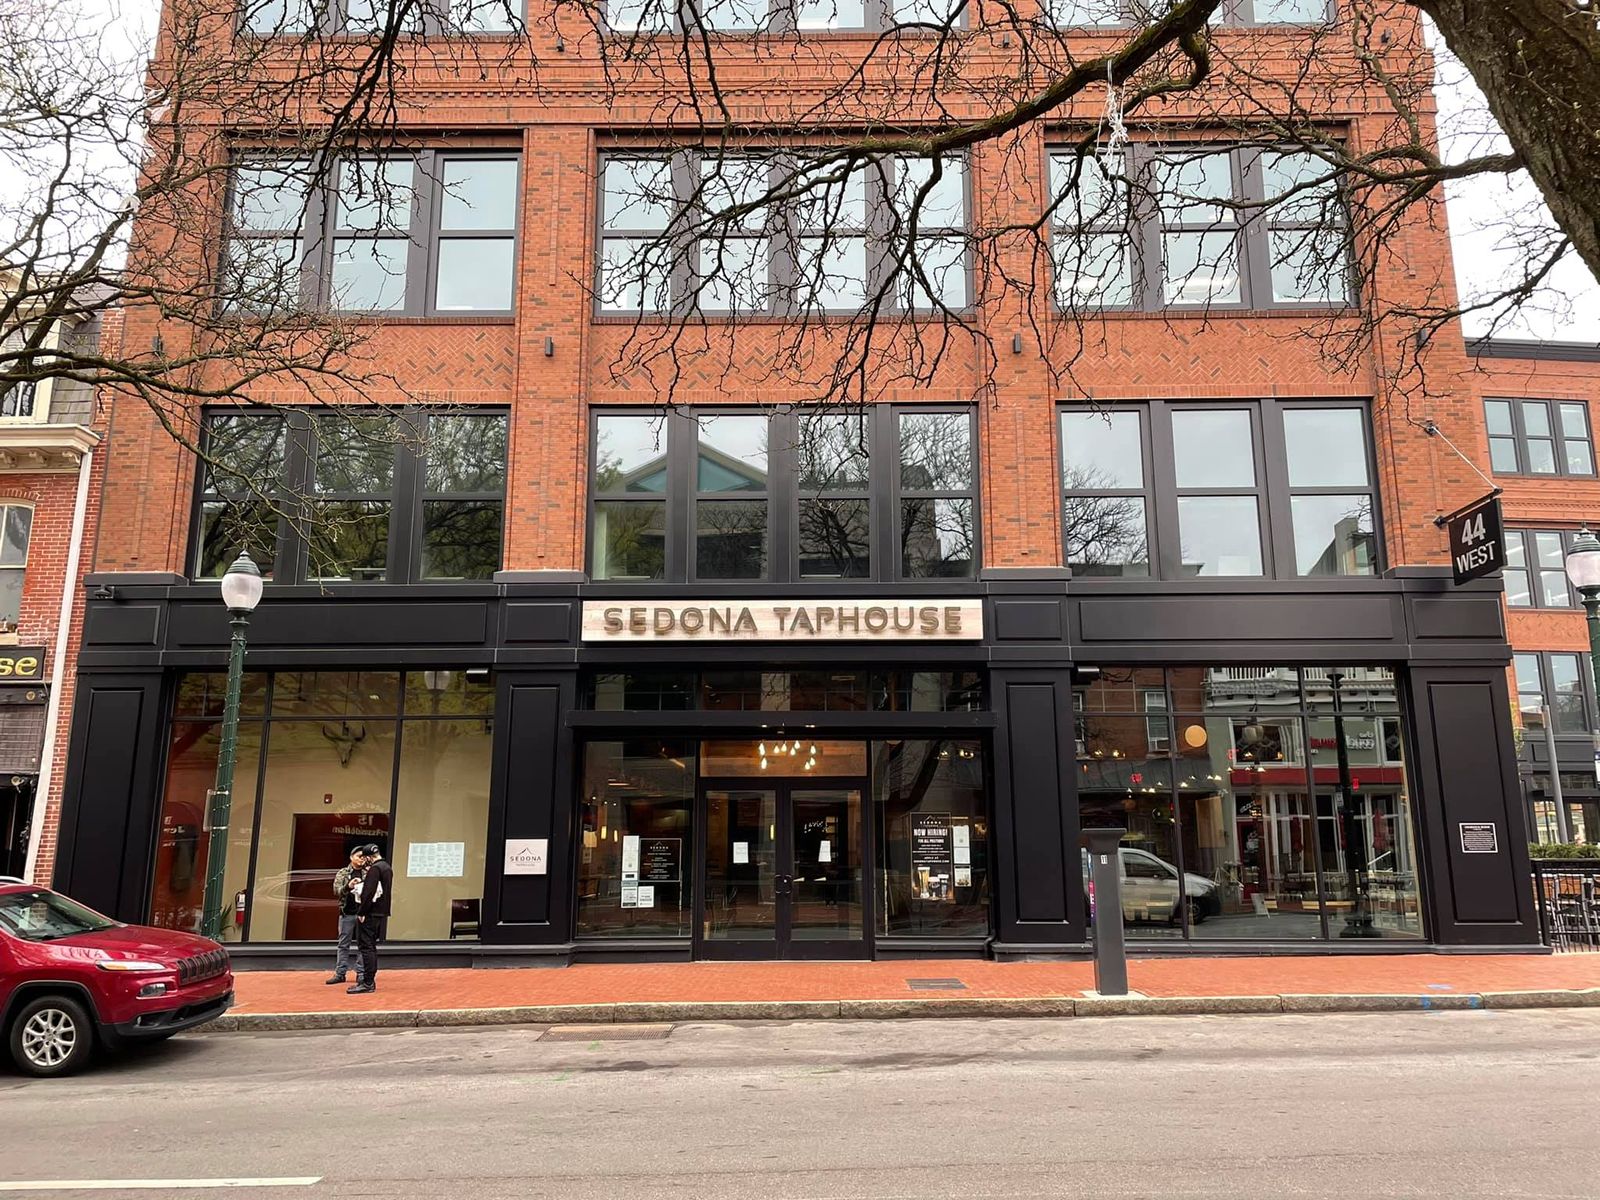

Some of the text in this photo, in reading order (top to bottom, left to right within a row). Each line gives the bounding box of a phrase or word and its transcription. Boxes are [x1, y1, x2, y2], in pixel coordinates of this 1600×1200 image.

[1461, 513, 1487, 546] 44
[1456, 540, 1496, 574] WEST
[603, 607, 962, 634] SEDONA TAPHOUSE
